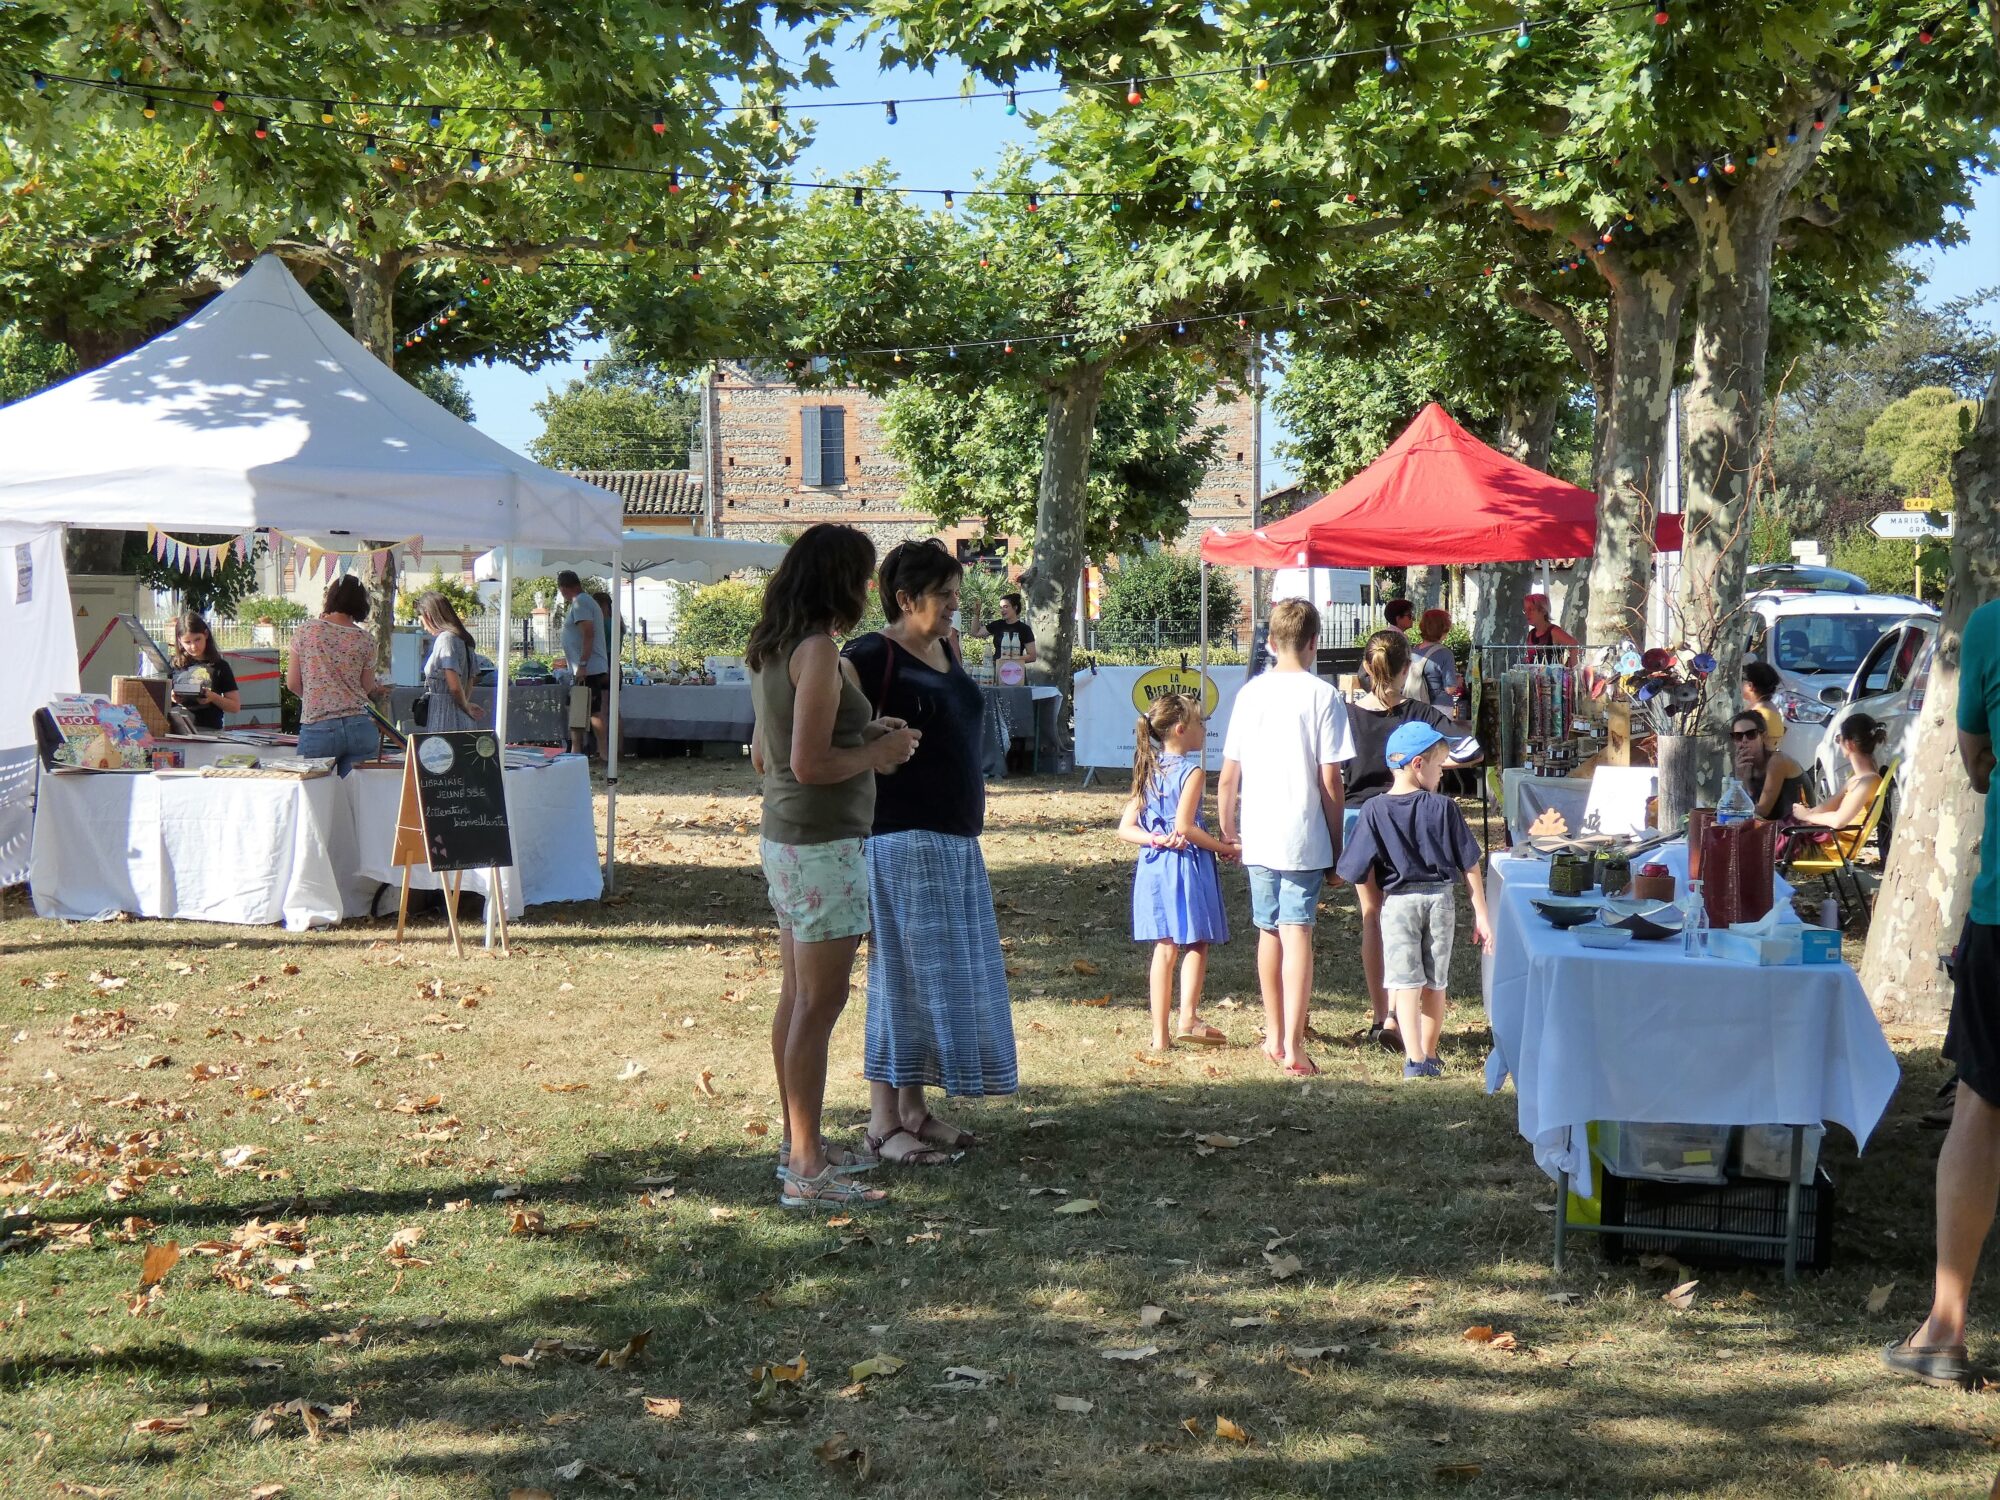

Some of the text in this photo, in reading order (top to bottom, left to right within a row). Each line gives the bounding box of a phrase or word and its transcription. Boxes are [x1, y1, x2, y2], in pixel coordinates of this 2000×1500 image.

[1170, 673, 1179, 683] LA
[420, 776, 463, 788] LIBRAIRIE
[437, 788, 486, 798] JEUNESSE
